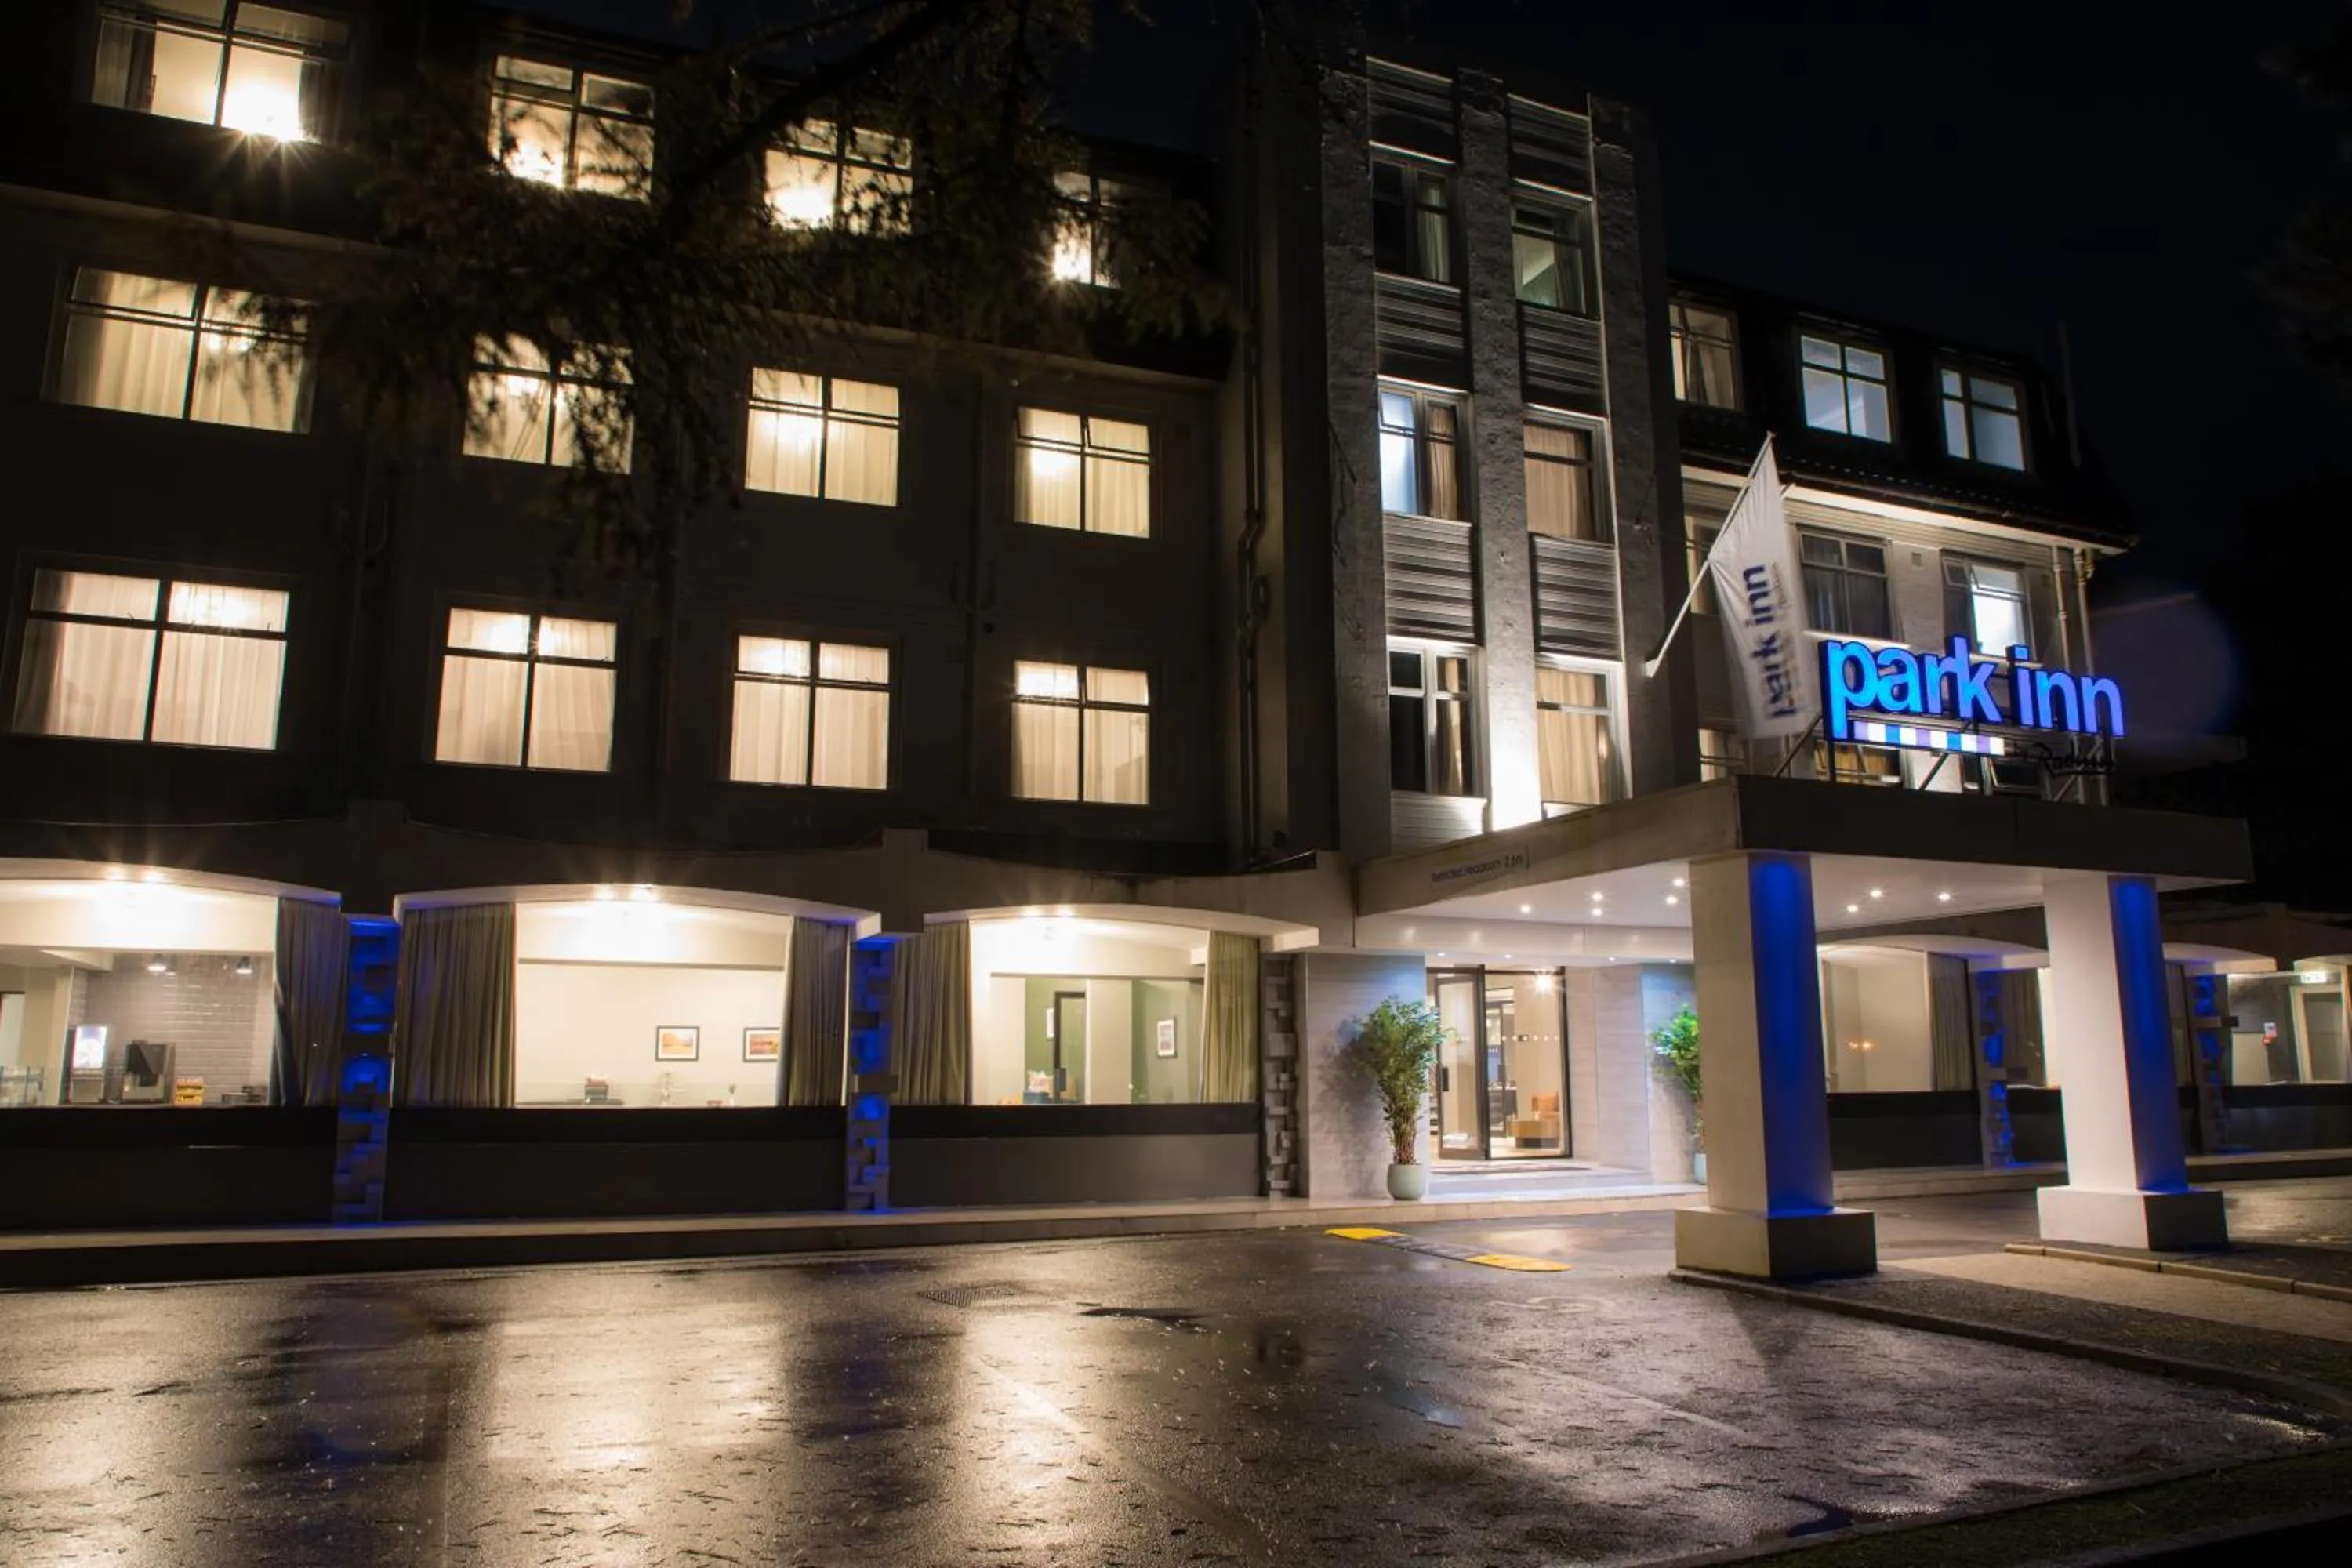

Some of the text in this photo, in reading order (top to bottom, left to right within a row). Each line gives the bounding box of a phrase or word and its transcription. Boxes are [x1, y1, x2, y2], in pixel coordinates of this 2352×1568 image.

[1743, 564, 1774, 627] inn
[1819, 636, 2125, 741] park inn
